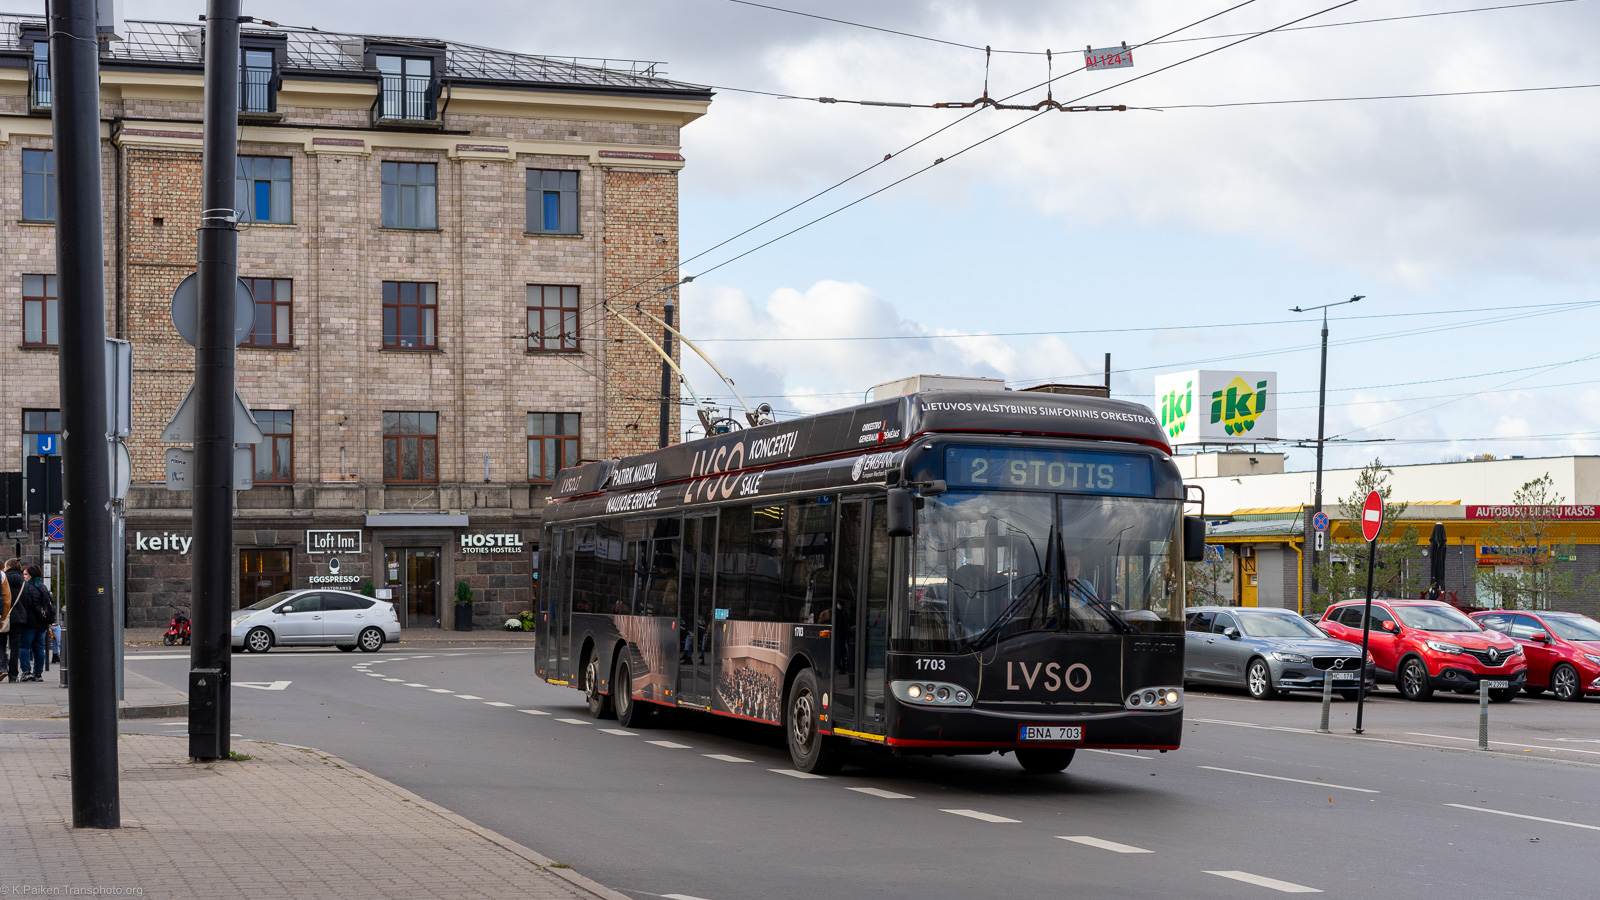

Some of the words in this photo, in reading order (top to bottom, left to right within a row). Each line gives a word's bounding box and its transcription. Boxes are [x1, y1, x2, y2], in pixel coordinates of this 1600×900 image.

[1161, 380, 1192, 427] iki
[1210, 380, 1267, 424] iki
[921, 402, 972, 411] LIETUVOS
[973, 403, 1037, 415] VALSTYBINIS
[1039, 407, 1099, 419] SIMFONINIS
[1101, 412, 1156, 425] ORKESTRAS
[42, 437, 52, 451] J
[749, 430, 799, 457] KONCERTŲ
[684, 441, 745, 503] LVSO
[971, 458, 988, 483] 2
[1010, 460, 1114, 489] STOTIS
[1565, 506, 1595, 517] KASOS
[314, 533, 335, 548] Loft
[337, 534, 355, 548] Inn
[461, 534, 523, 547] HOSTEL
[309, 575, 360, 584] EGGSPRESSO
[915, 658, 946, 671] 1703
[1006, 661, 1092, 692] LVSO
[1028, 728, 1052, 739] BNA
[1060, 728, 1080, 739] 703
